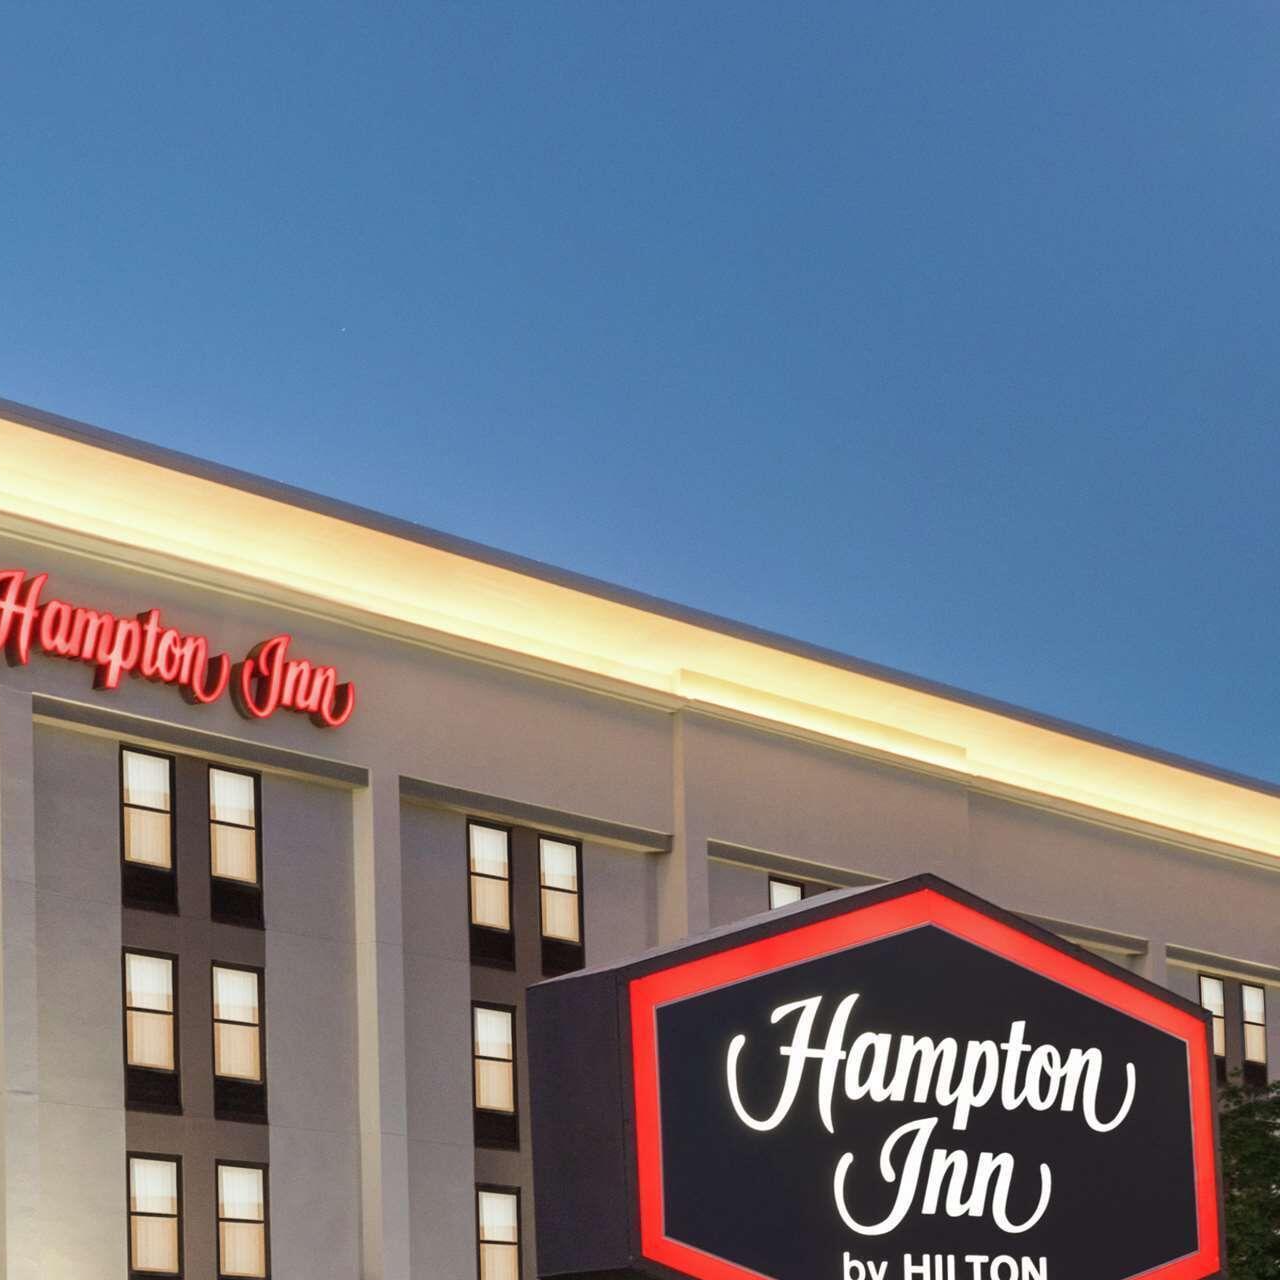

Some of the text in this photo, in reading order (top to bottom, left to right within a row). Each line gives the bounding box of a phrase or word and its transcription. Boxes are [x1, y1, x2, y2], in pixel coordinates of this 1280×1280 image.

[235, 634, 355, 728] Inn
[726, 992, 1137, 1134] Hampton
[833, 1116, 1052, 1236] Inn
